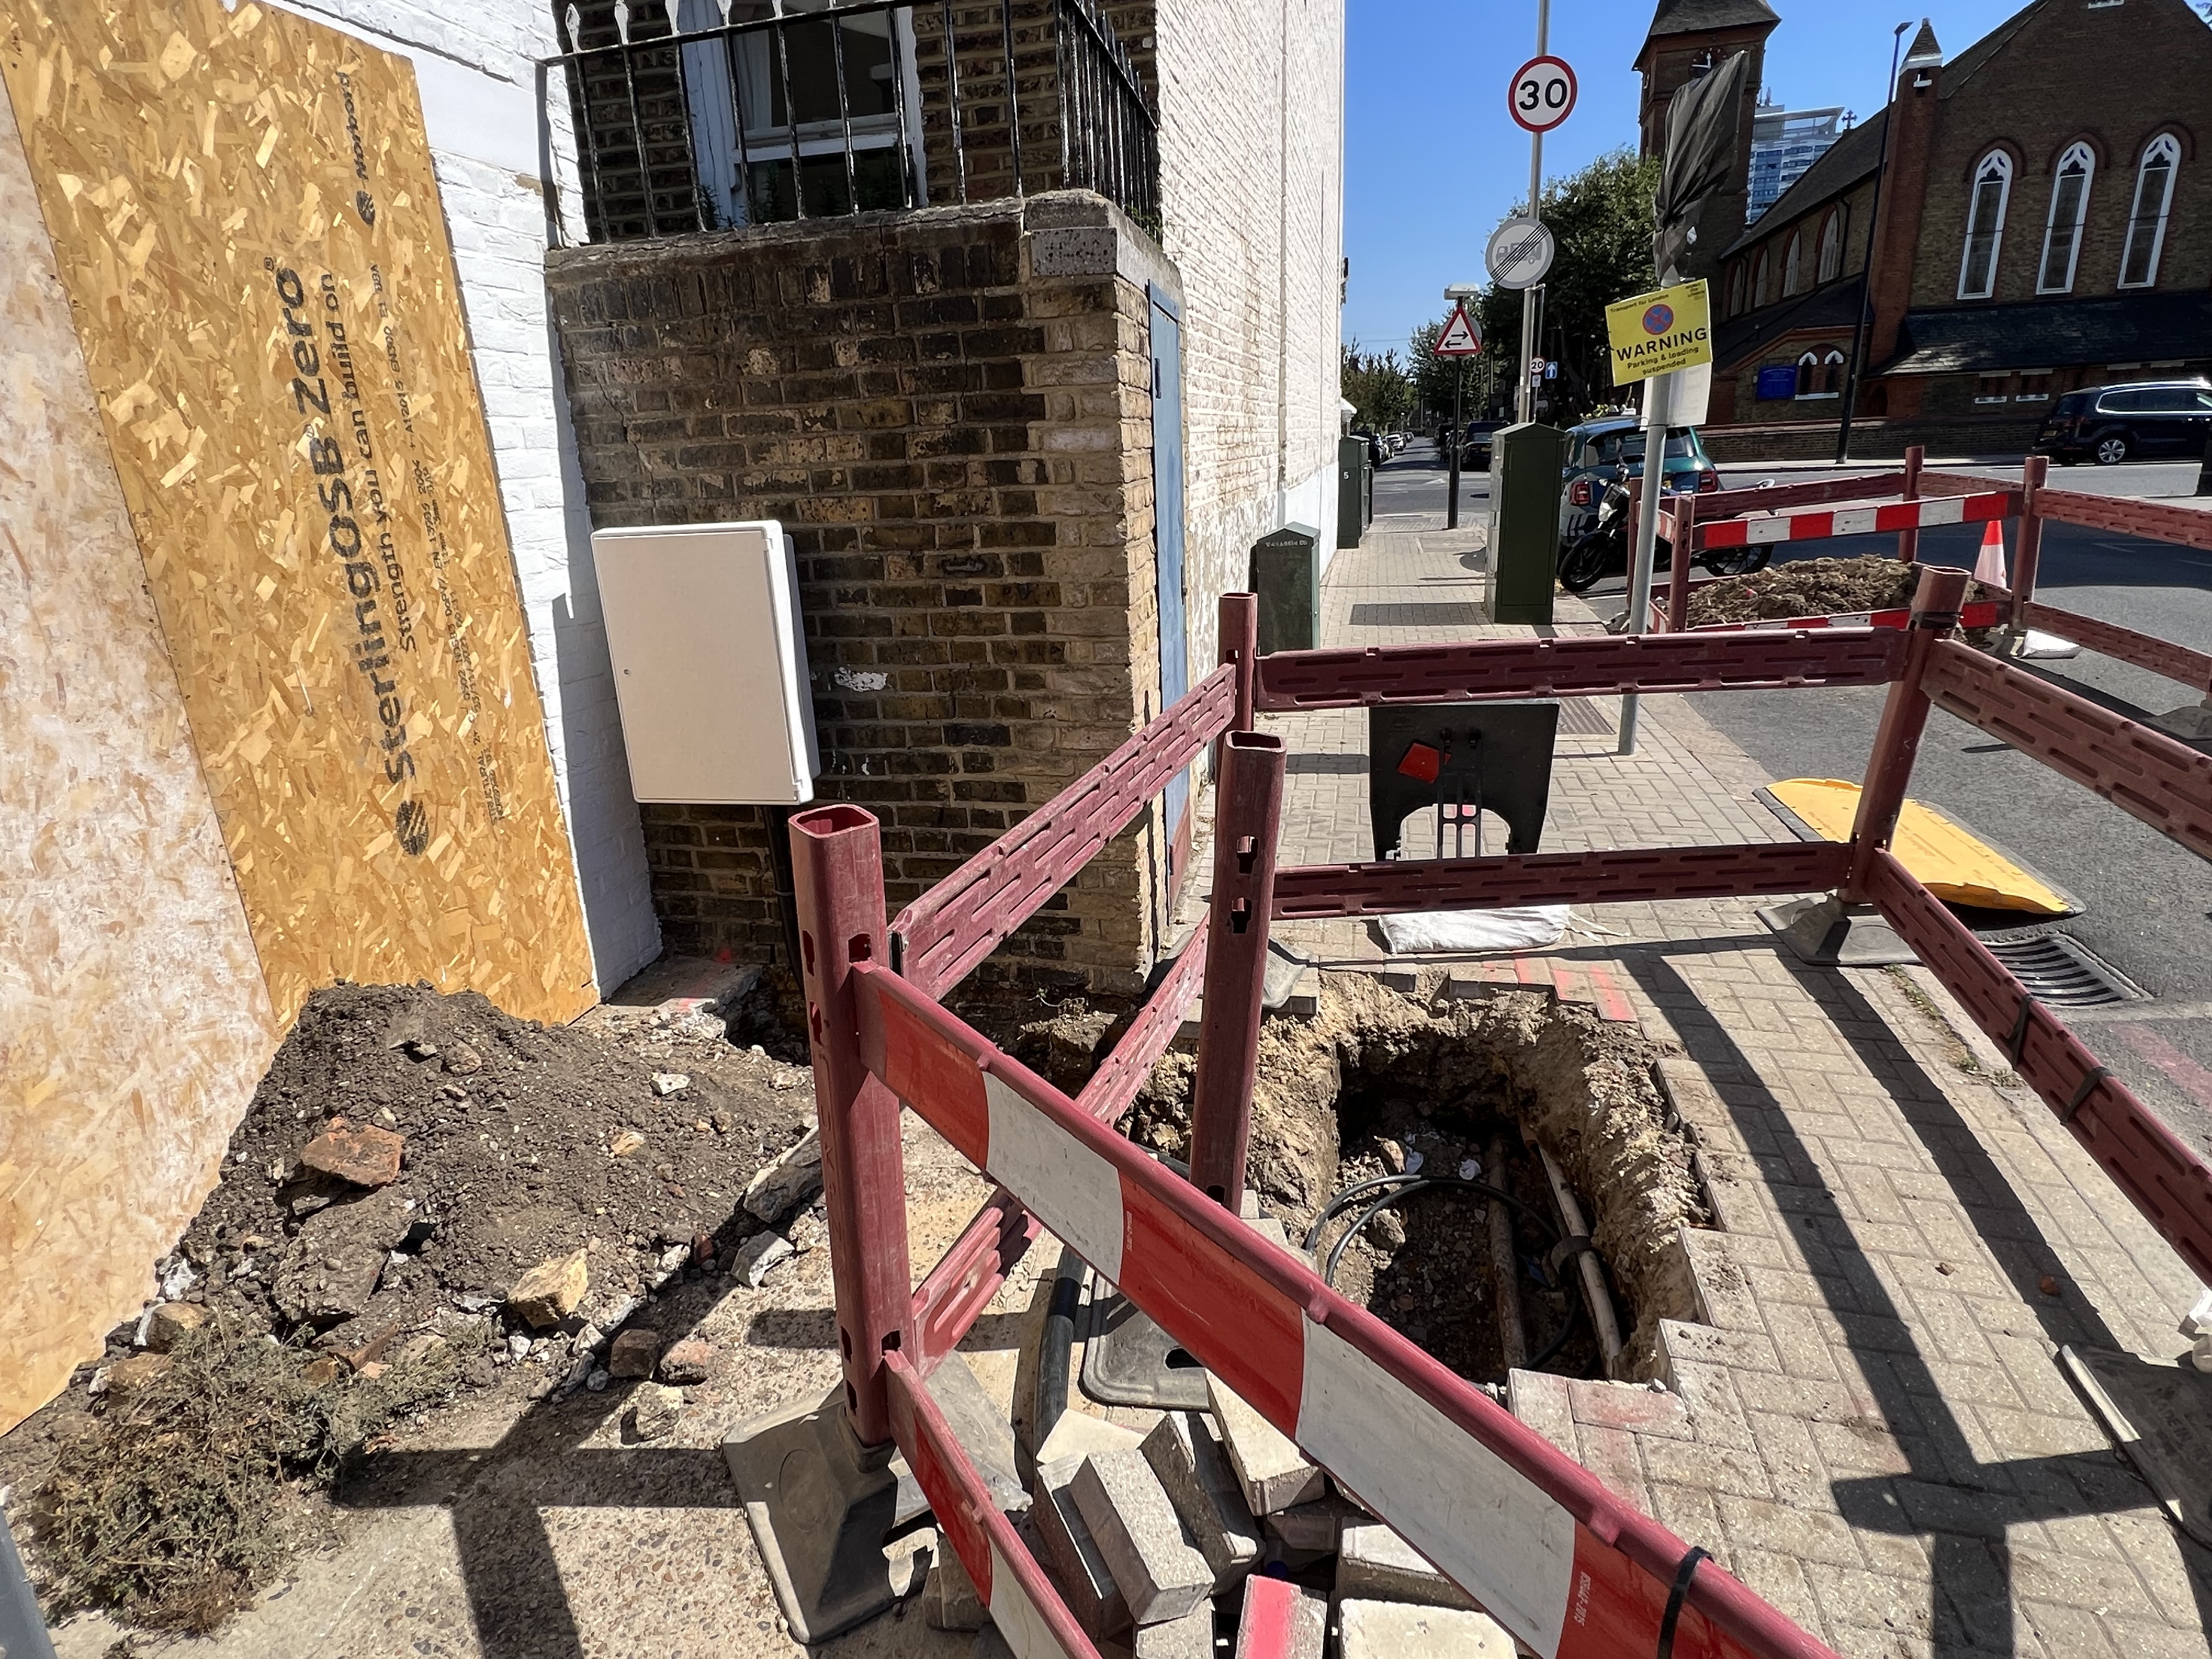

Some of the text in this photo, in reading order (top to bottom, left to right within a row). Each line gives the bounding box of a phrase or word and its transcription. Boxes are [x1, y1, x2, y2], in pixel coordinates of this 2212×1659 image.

[1519, 78, 1567, 110] 30
[335, 71, 368, 180] Norbord
[1617, 328, 1707, 361] WARNING
[1627, 358, 1658, 369] Parking
[1669, 347, 1699, 359] loading
[1643, 358, 1686, 375] suspended
[321, 274, 417, 652] Strength you can build on
